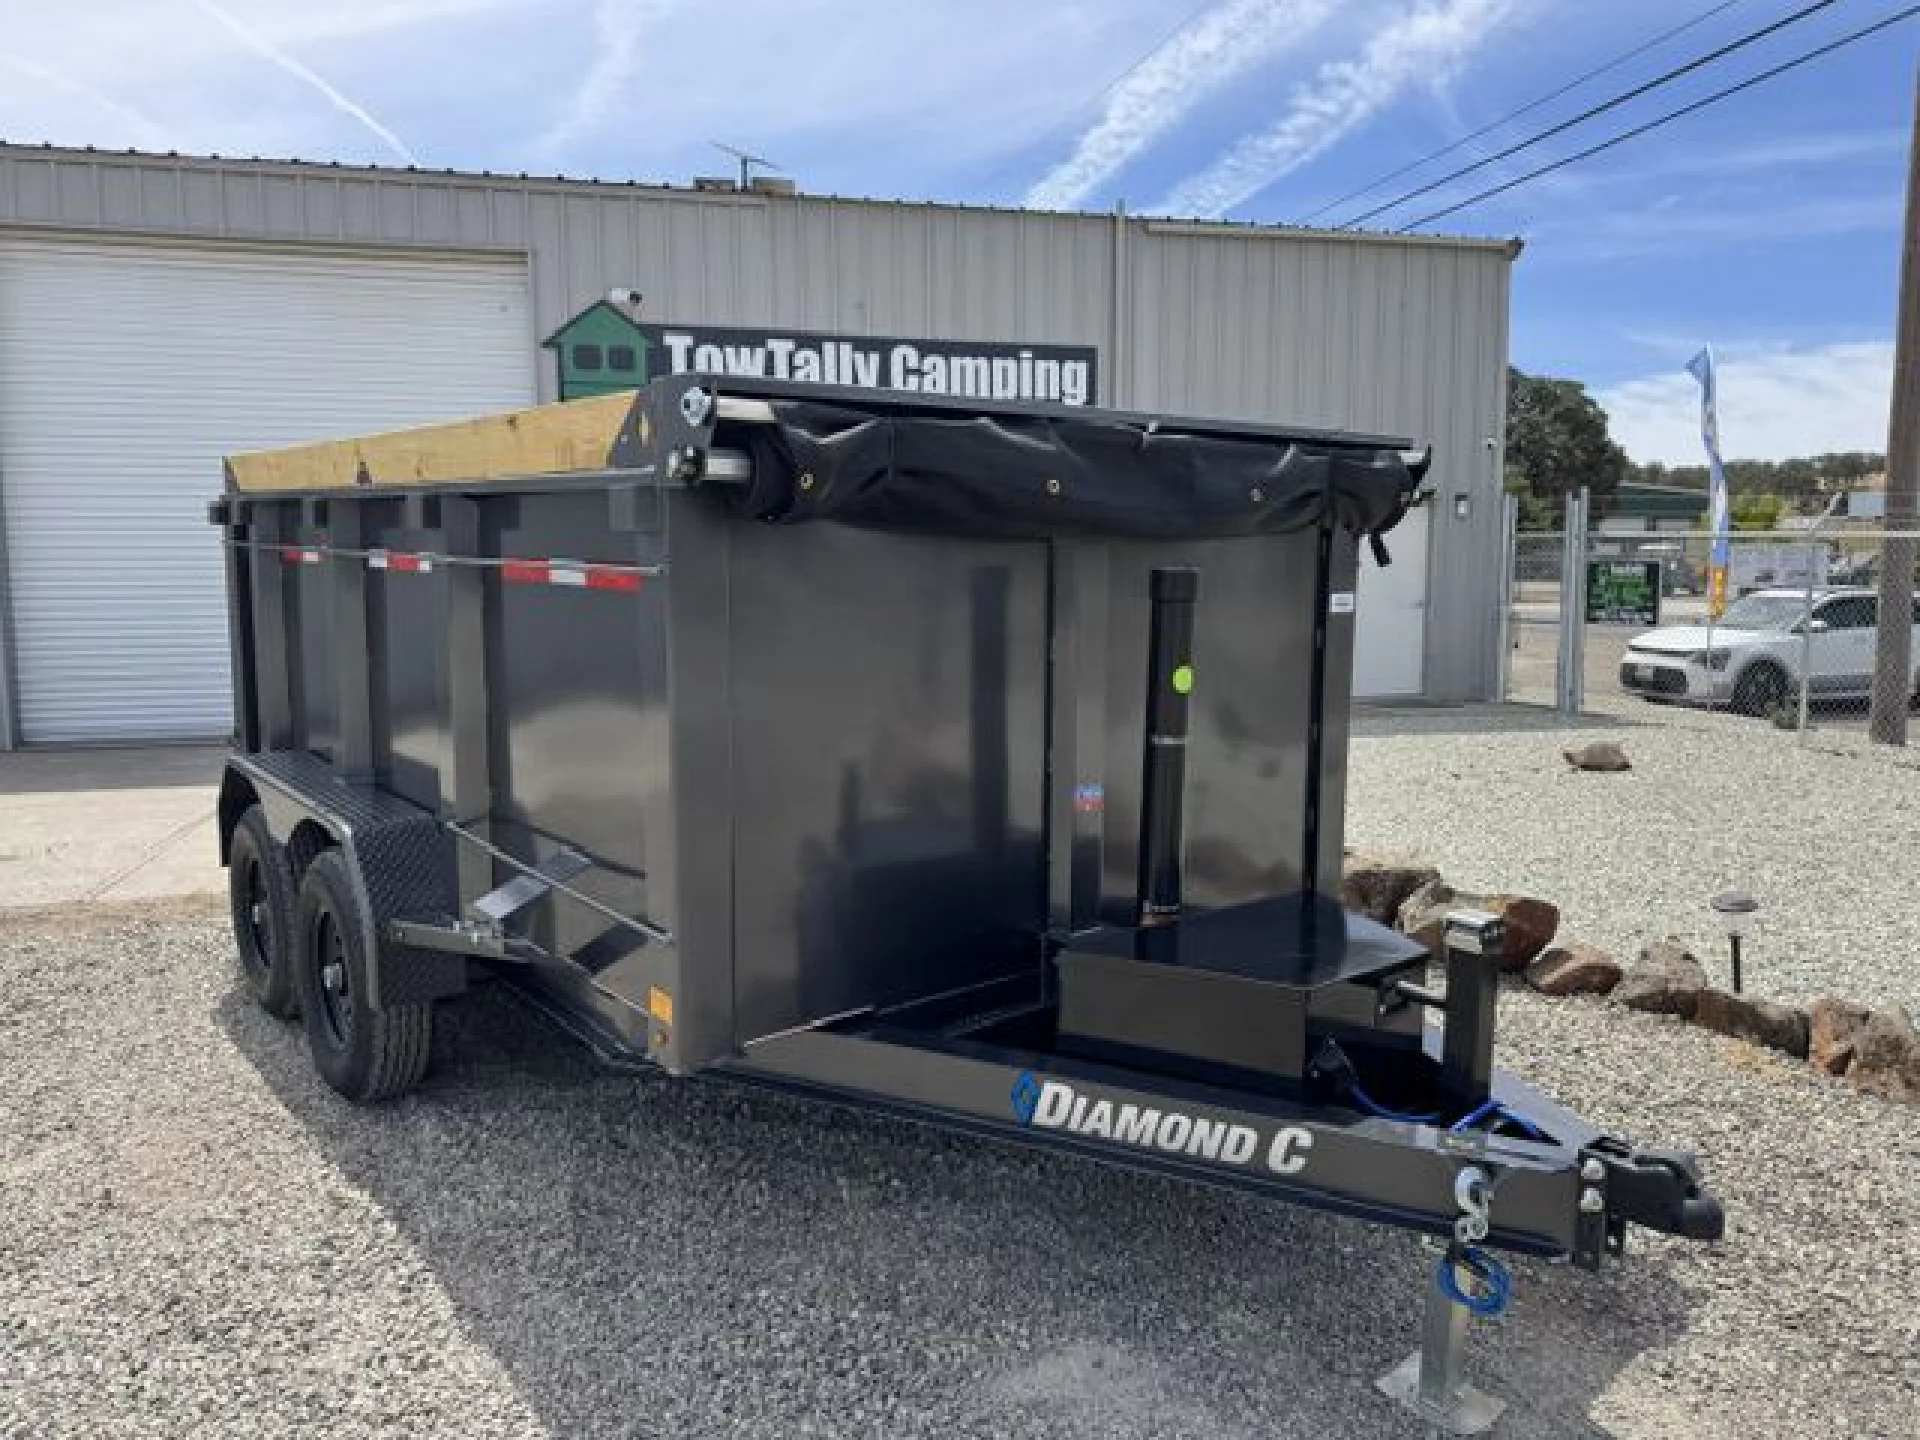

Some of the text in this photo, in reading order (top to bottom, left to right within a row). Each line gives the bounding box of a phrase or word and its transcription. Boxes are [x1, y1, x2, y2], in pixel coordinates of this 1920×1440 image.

[664, 334, 1088, 406] TowTally Camping
[1267, 1126, 1313, 1174] C
